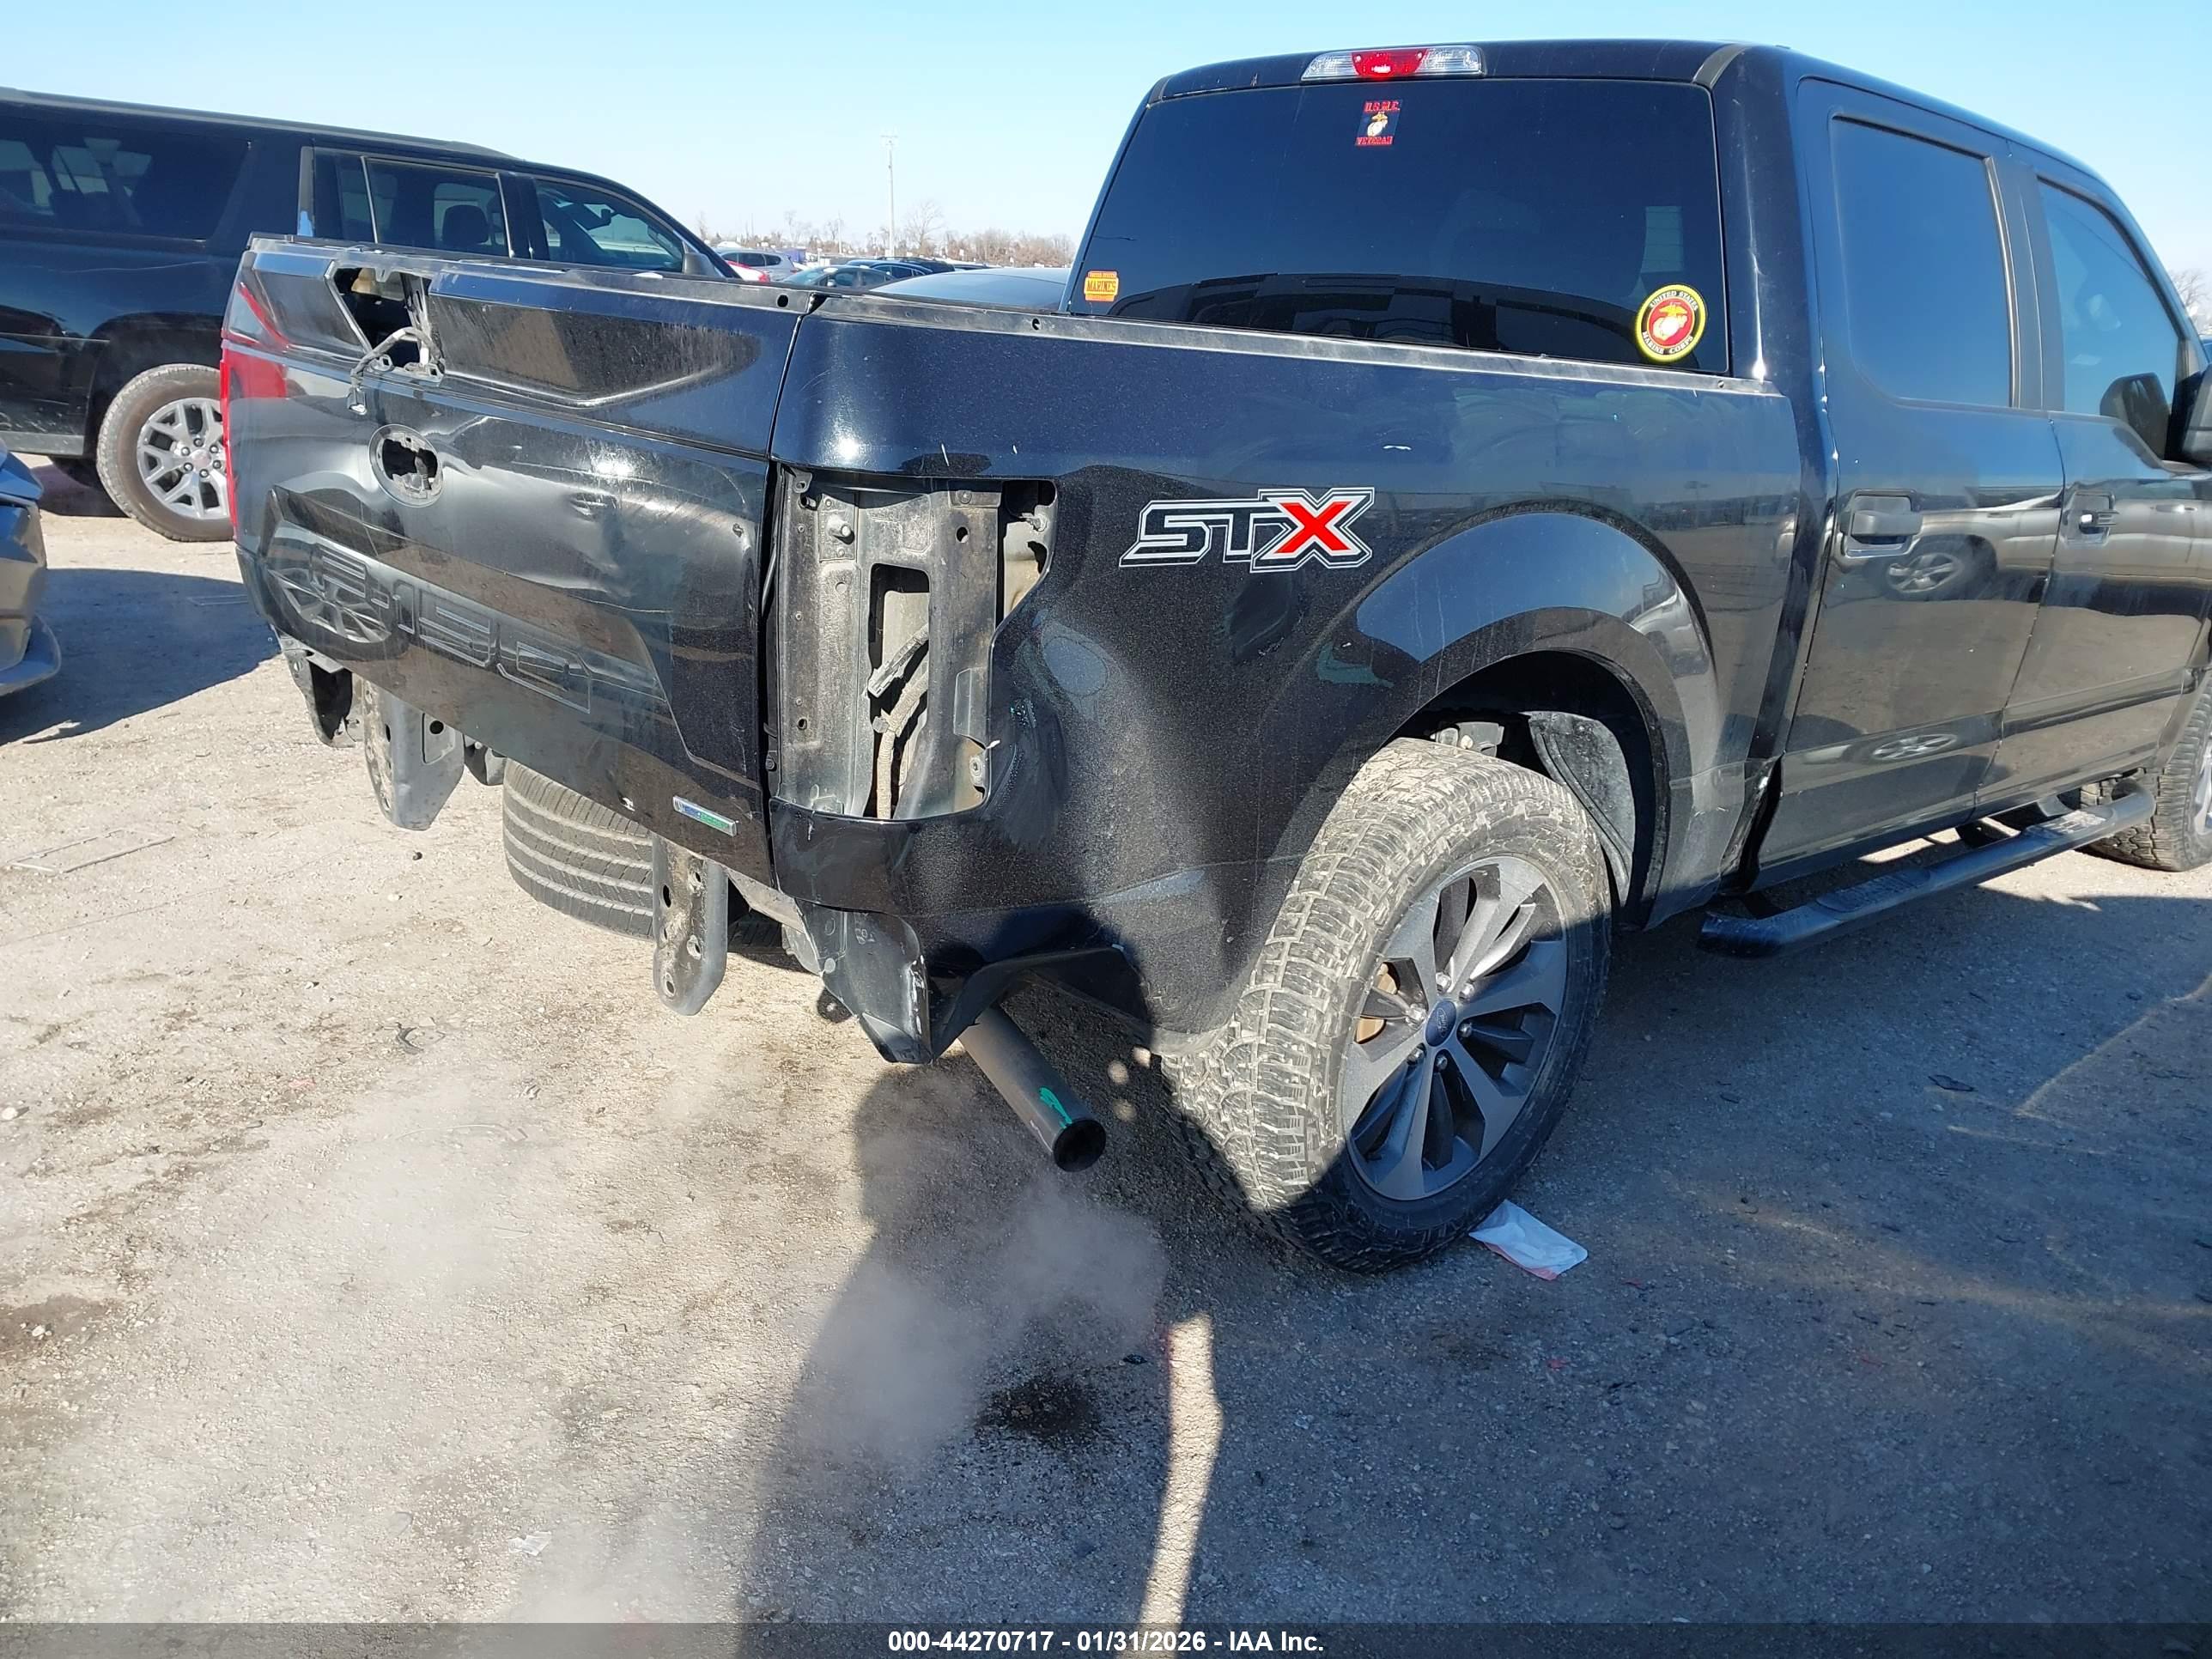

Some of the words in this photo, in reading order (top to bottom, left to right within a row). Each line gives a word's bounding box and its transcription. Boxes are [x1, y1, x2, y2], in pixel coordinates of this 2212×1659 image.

[1086, 280, 1116, 292] MARINES
[1650, 290, 1677, 308] UNITED
[1679, 290, 1698, 311] STATES
[1642, 331, 1664, 355] MARINE
[1668, 335, 1693, 354] CORPS
[1119, 487, 1374, 573] STX
[309, 542, 592, 714] F-150
